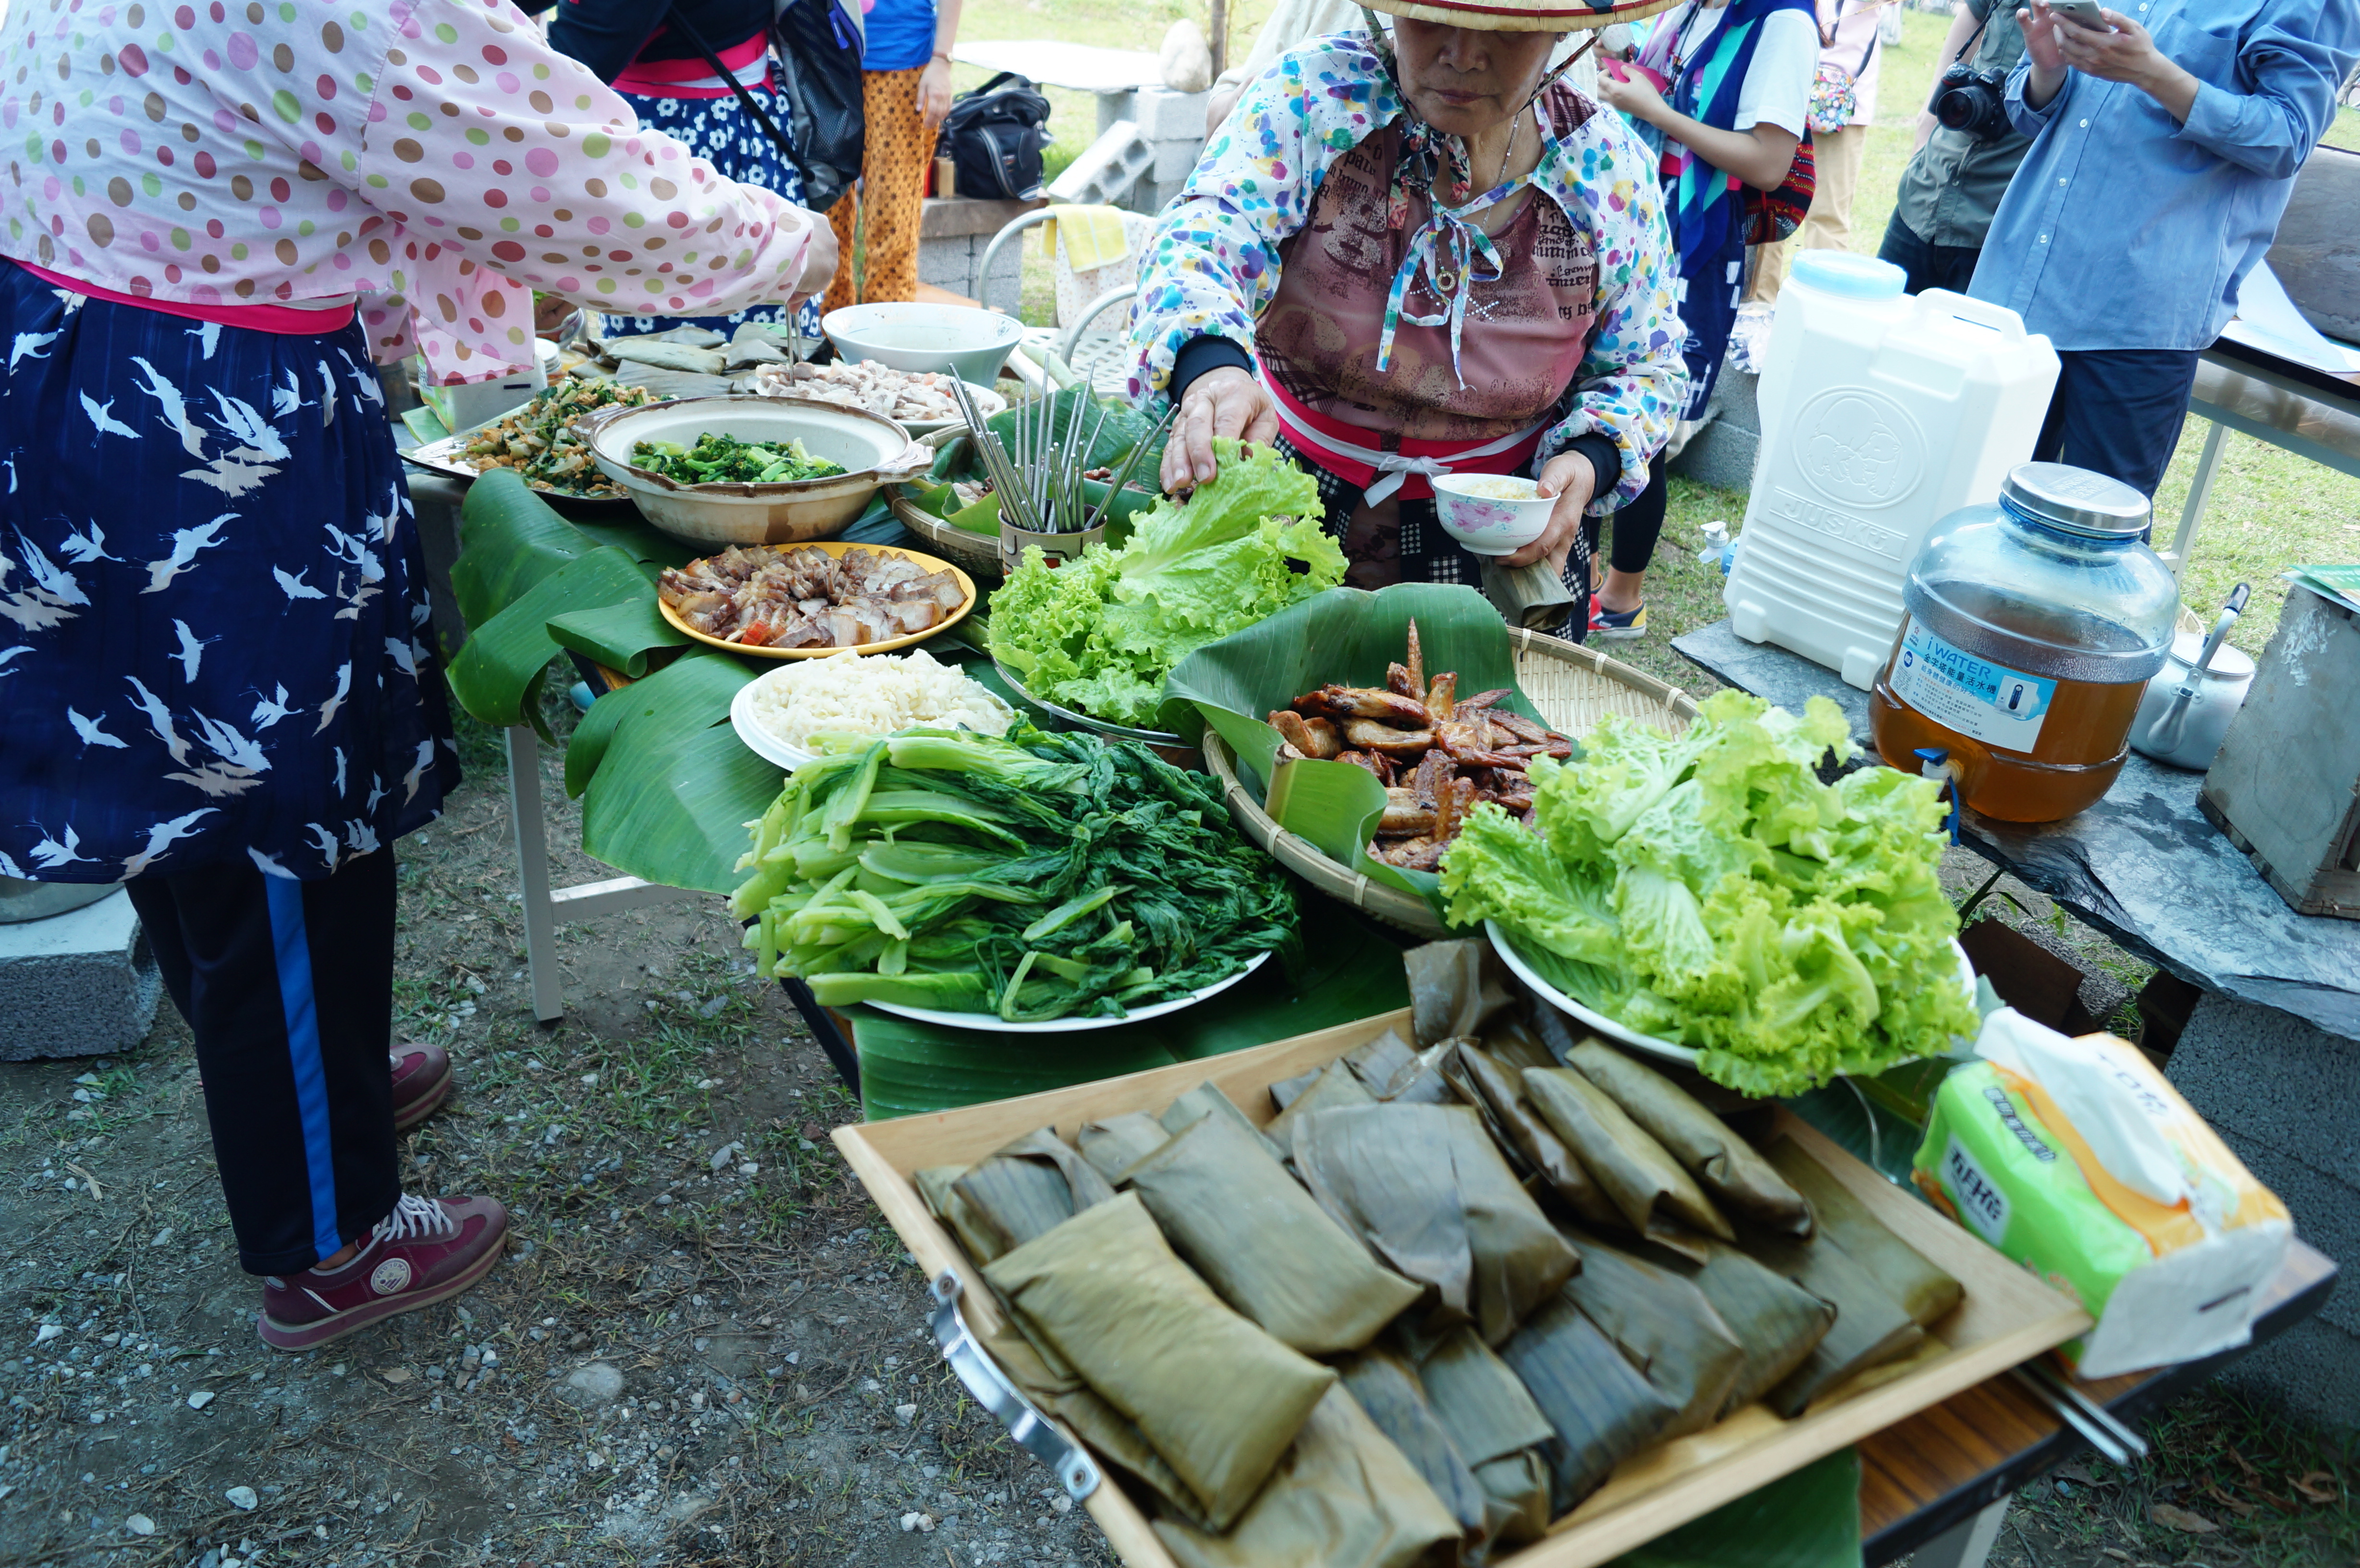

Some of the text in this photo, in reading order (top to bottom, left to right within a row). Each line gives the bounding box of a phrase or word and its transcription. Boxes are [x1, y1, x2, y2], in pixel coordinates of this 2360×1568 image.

[1979, 75, 1993, 84] Nikon
[1923, 653, 1997, 695] 金字塔能量活水機
[1935, 643, 1991, 680] WATER
[1920, 664, 1977, 697] 給身體健康的好水
